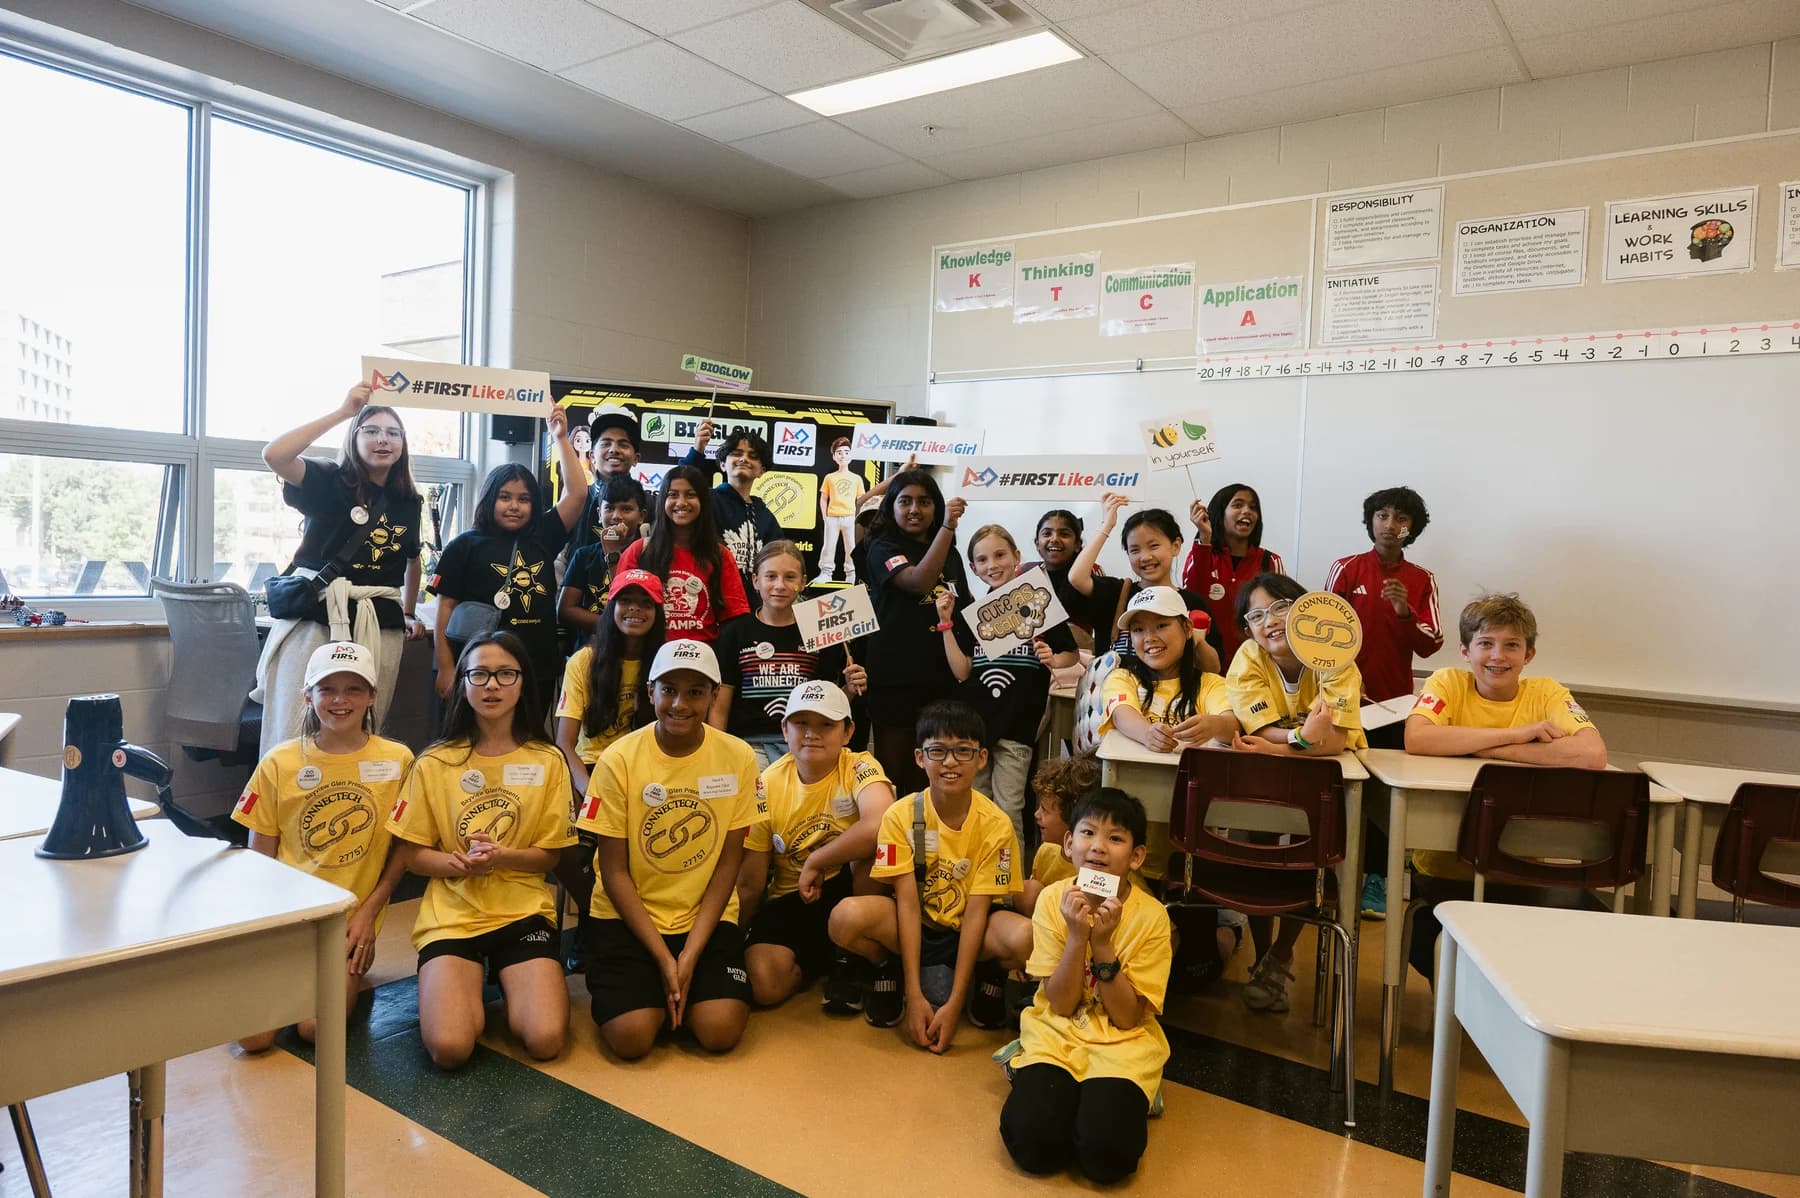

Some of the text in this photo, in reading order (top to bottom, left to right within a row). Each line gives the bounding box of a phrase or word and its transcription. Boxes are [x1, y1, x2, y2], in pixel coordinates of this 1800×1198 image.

[1332, 195, 1413, 212] RESPONSIBILITY
[1615, 200, 1748, 224] LEARNING SKILLS
[1461, 217, 1556, 235] ORGANIZATION
[1625, 233, 1672, 248] WORK
[941, 249, 1012, 269] Knowledge
[1620, 250, 1673, 264] HABITS
[969, 273, 981, 288] K
[1022, 263, 1094, 281] Thinking
[1105, 267, 1191, 293] Communication
[1328, 277, 1379, 288] INITIATIVE
[1051, 287, 1062, 301] T
[1140, 295, 1152, 309] C
[1203, 283, 1298, 307] Application
[1241, 311, 1256, 326] A
[1197, 368, 1214, 378] -20
[1217, 367, 1231, 377] -19
[1236, 366, 1250, 376] -18
[1256, 365, 1271, 376] -17
[1276, 364, 1290, 374] -16
[1296, 363, 1311, 373] -15
[1316, 362, 1331, 372] -14
[1338, 361, 1353, 371] -13
[1360, 360, 1375, 370] -12
[1383, 358, 1396, 369] -11
[1406, 357, 1422, 368] -10
[1431, 356, 1444, 367] -9
[1455, 355, 1468, 365] -8
[1479, 354, 1493, 364] -7
[1503, 352, 1517, 363] -6
[1528, 351, 1543, 361] -5
[1553, 349, 1568, 360] -4
[1581, 348, 1595, 359] -3
[1608, 347, 1622, 358] -2
[1639, 345, 1647, 357] -1
[1670, 344, 1679, 355] 0
[1703, 342, 1706, 353] 1
[1729, 340, 1740, 352] 2
[1760, 339, 1771, 350] 3
[700, 361, 750, 380] BIOGLOW
[412, 380, 544, 402] #FIRSTLikeAGirl
[776, 445, 813, 456] FIRST
[882, 440, 976, 455] #FIRSTLikeAGirl
[1151, 443, 1215, 468] in yourself
[999, 473, 1139, 486] #FIRSTLikeAGirl
[982, 587, 1034, 622] cute as
[1134, 594, 1155, 606] FIRST
[1298, 596, 1355, 624] CONNECTECH
[666, 620, 703, 630] AMPS
[818, 610, 854, 631] FIRST
[993, 613, 1020, 634] can
[806, 618, 876, 650] #LikeAGirl
[331, 653, 359, 661] FIRST
[1312, 657, 1336, 667] 27757
[759, 664, 800, 675] WE ARE
[1250, 700, 1269, 714] IVAN
[856, 767, 879, 784] JACOB
[304, 784, 329, 800] Bayview
[348, 781, 373, 794] Presents
[303, 792, 362, 830] CONNECTECH
[459, 799, 510, 837] CONNECTECH
[643, 800, 698, 836] CONNECTECH
[339, 845, 364, 863] 27757
[683, 849, 706, 868] 27757
